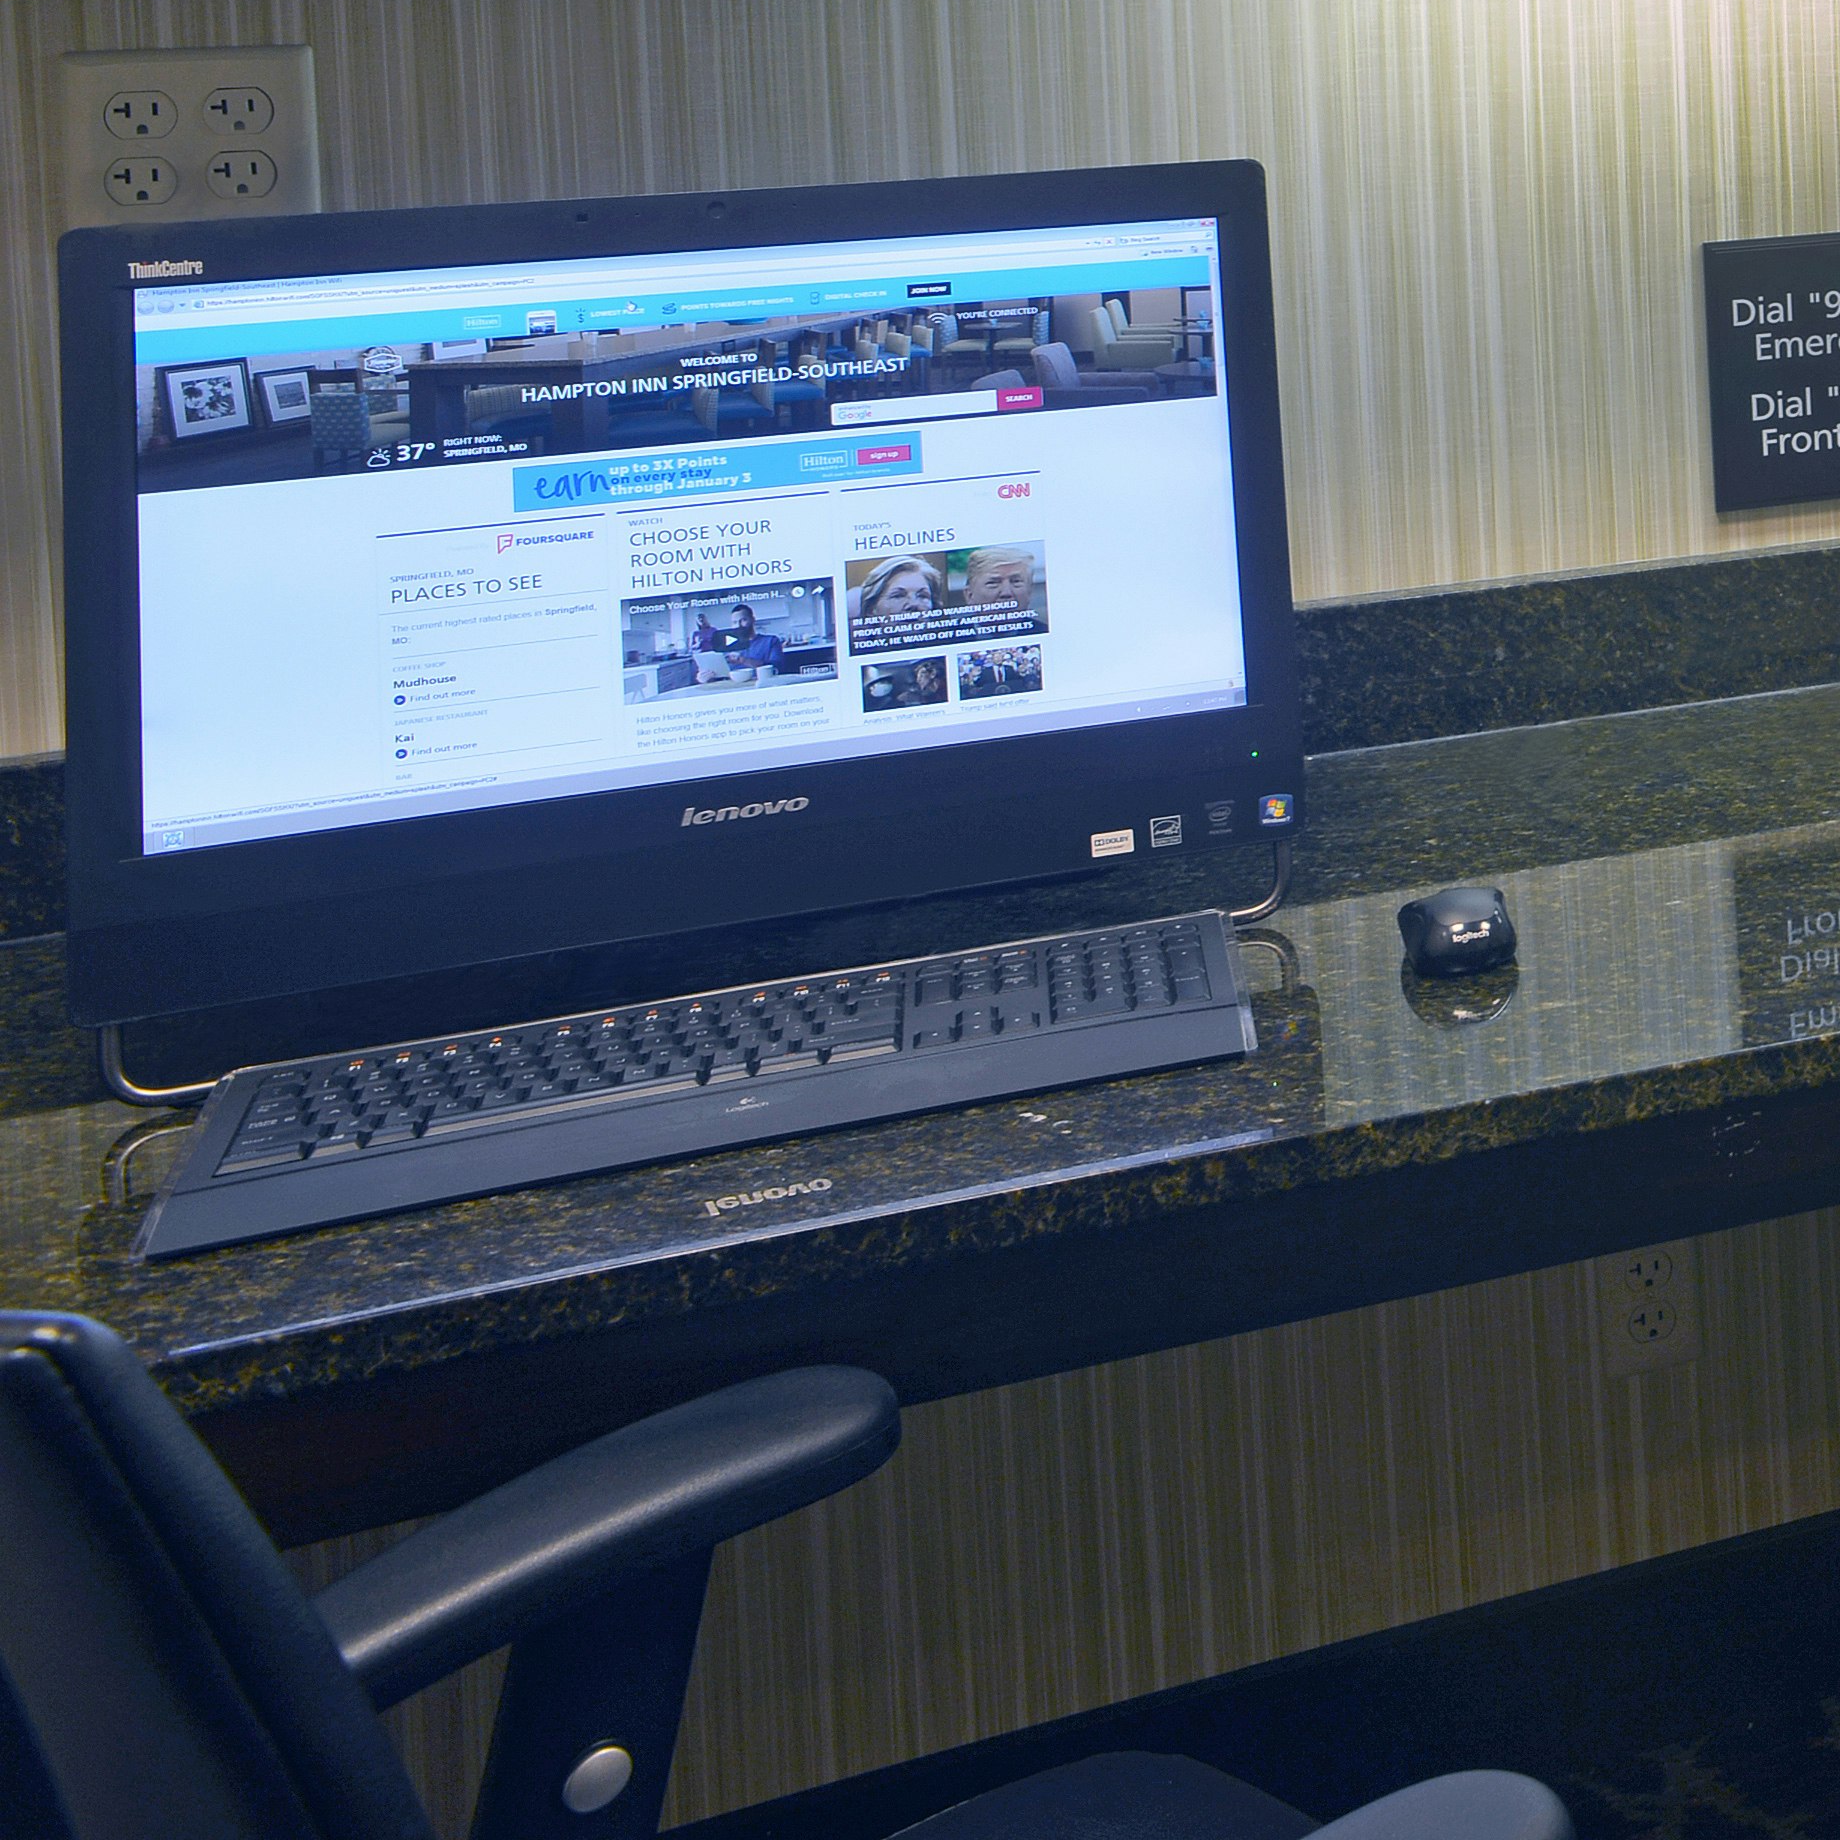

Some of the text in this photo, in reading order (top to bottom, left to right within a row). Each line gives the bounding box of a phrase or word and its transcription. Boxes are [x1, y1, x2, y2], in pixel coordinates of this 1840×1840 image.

[128, 260, 204, 279] ThinkCentre
[956, 306, 1038, 320] YOU'RE CONNECTED
[1732, 293, 1793, 326] Dial
[680, 353, 757, 368] WELCOME TO
[521, 357, 908, 403] HAMPTON INN SPRINGFIELD-SOUTHEAST
[1005, 394, 1033, 403] SEARCH
[1751, 387, 1812, 421] Dial
[838, 409, 872, 420] Google
[443, 443, 527, 458] SPRINGFIELD, MO
[444, 435, 503, 447] RIGHT NOW:
[396, 442, 435, 462] 37°
[803, 453, 844, 468] Hilton
[870, 449, 898, 460] sign up
[609, 456, 727, 476] up to 3X Points
[534, 470, 611, 501] earn
[610, 473, 752, 496] through January 3
[611, 469, 712, 485] on every stay
[997, 482, 1031, 498] CNN
[628, 517, 663, 527] WATCH
[516, 531, 594, 547] FOURSQUARE
[630, 519, 771, 547] CHOOSE YOUR
[855, 528, 955, 551] HEADLINES
[631, 543, 751, 568] ROOM WITH
[457, 568, 474, 576] MO
[632, 559, 792, 589] HILTON HONORS
[391, 575, 542, 604] PLACES TO SEE
[629, 592, 770, 615] Choose Your Room with Hilton
[923, 609, 942, 618] SAID
[983, 600, 1017, 611] SHOULD
[391, 625, 409, 633] The
[411, 621, 442, 631] current
[445, 617, 477, 628] highest
[479, 613, 502, 623] rated
[504, 611, 533, 621] places
[545, 603, 597, 617] Springfield,
[853, 628, 882, 638] PROVE
[884, 624, 912, 634] CLAIM
[914, 622, 926, 630] OF
[927, 618, 959, 629] NATIVE
[960, 613, 1006, 626] AMERICAN
[854, 639, 889, 649] TODAY,
[903, 632, 937, 643] WAVED
[977, 624, 997, 634] TEST
[998, 621, 1034, 633] RESULTS
[394, 674, 457, 689] Mudhouse
[410, 688, 476, 702] Find out more
[636, 699, 788, 724] Hilton Honors gives you more of what
[395, 733, 415, 743] Kai
[411, 747, 432, 756] Find
[453, 741, 477, 750] more
[680, 796, 810, 827] lenovo
